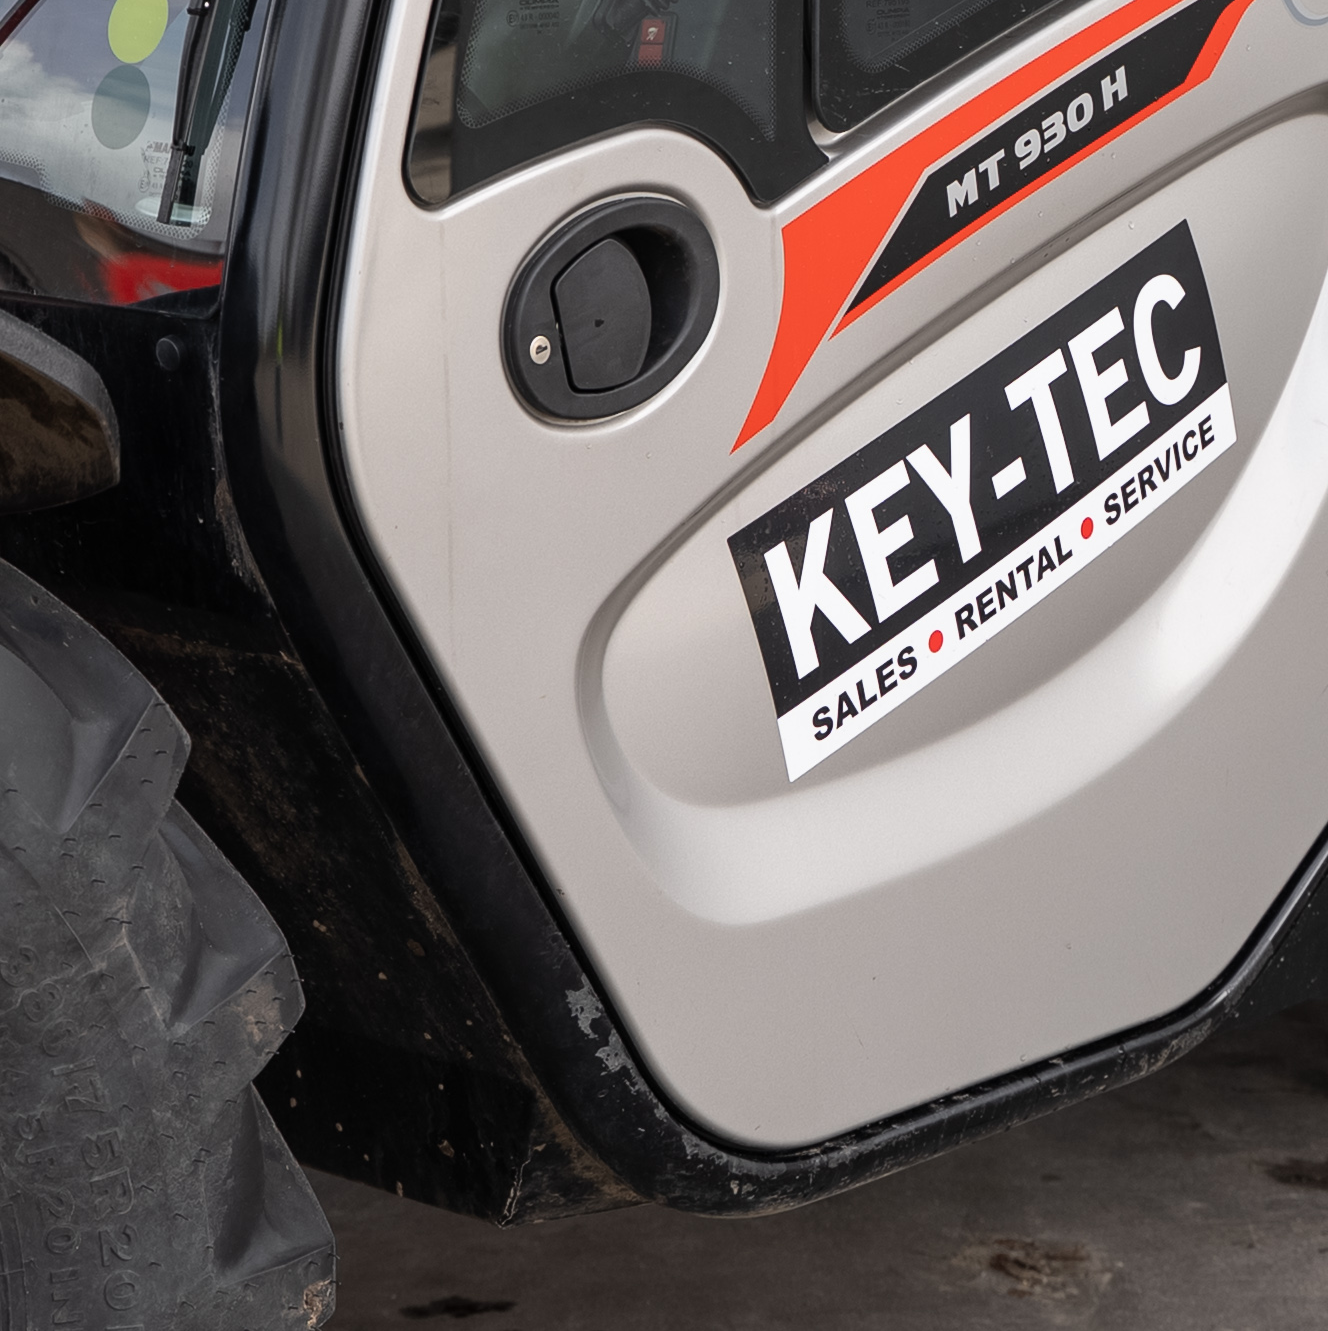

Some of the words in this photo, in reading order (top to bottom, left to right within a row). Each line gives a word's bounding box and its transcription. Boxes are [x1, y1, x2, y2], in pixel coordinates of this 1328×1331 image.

[947, 152, 1008, 217] MT
[1014, 102, 1094, 170] 930
[1102, 68, 1129, 121] H
[763, 273, 1203, 678] KEY-TEC
[811, 647, 919, 742] SALES
[953, 540, 1072, 640] RENTAL
[1103, 418, 1217, 525] SERVICE
